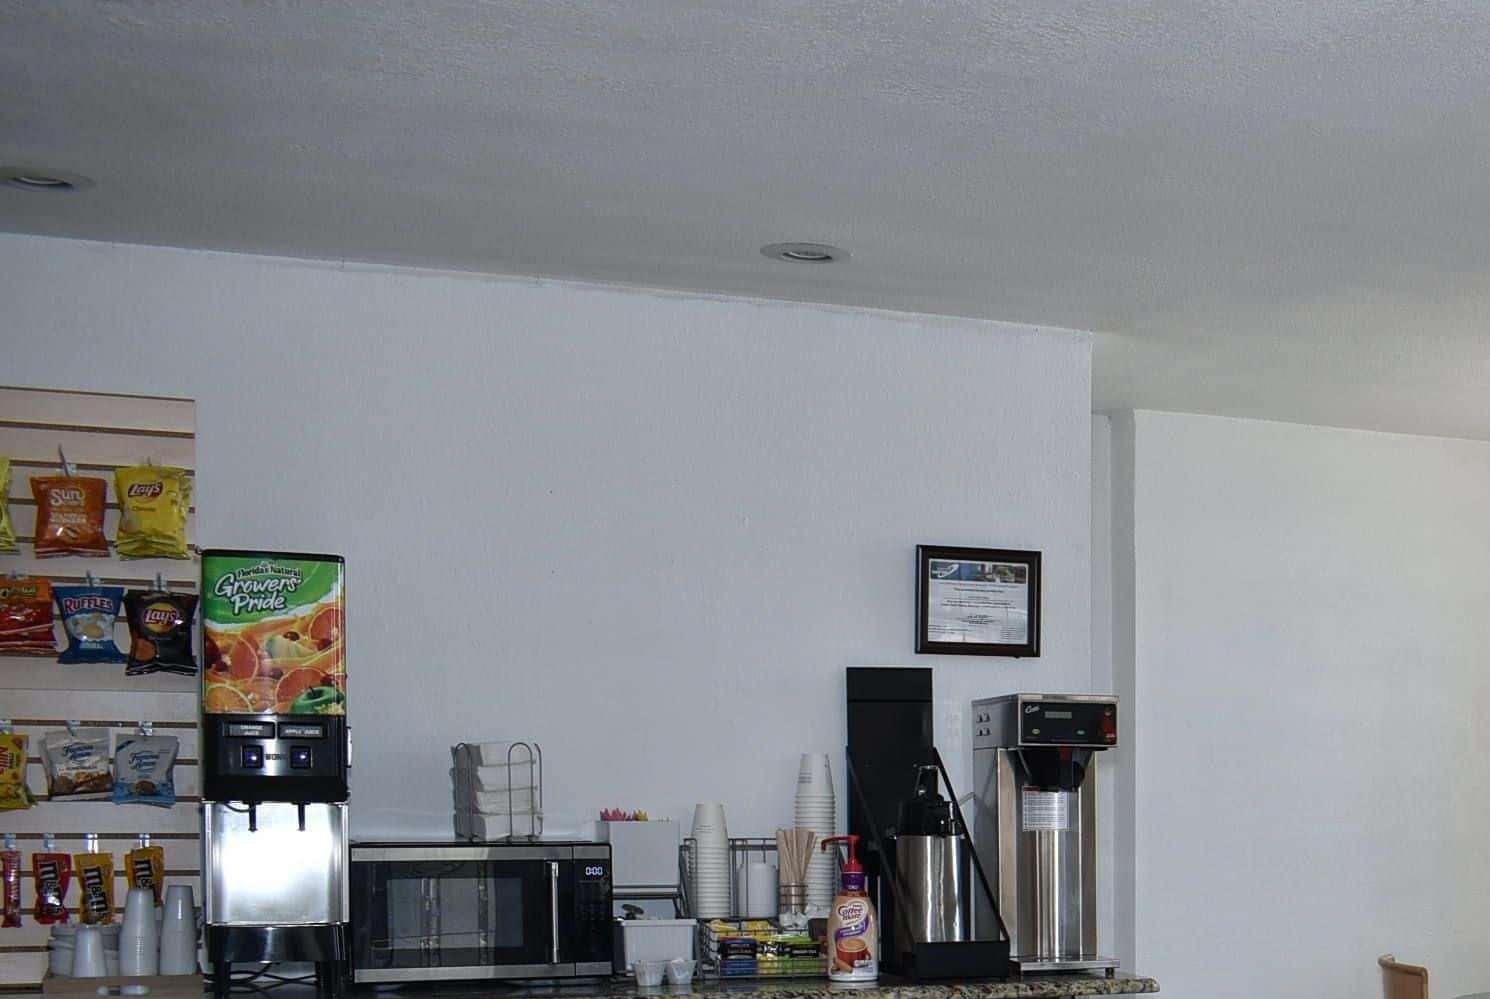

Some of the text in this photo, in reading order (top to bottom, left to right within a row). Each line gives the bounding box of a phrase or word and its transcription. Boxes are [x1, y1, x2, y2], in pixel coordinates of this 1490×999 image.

[50, 489, 84, 506] Sun
[129, 483, 162, 497] Lay's
[65, 597, 113, 613] RUFFLES
[231, 591, 285, 614] Pride
[586, 866, 603, 876] 0:00
